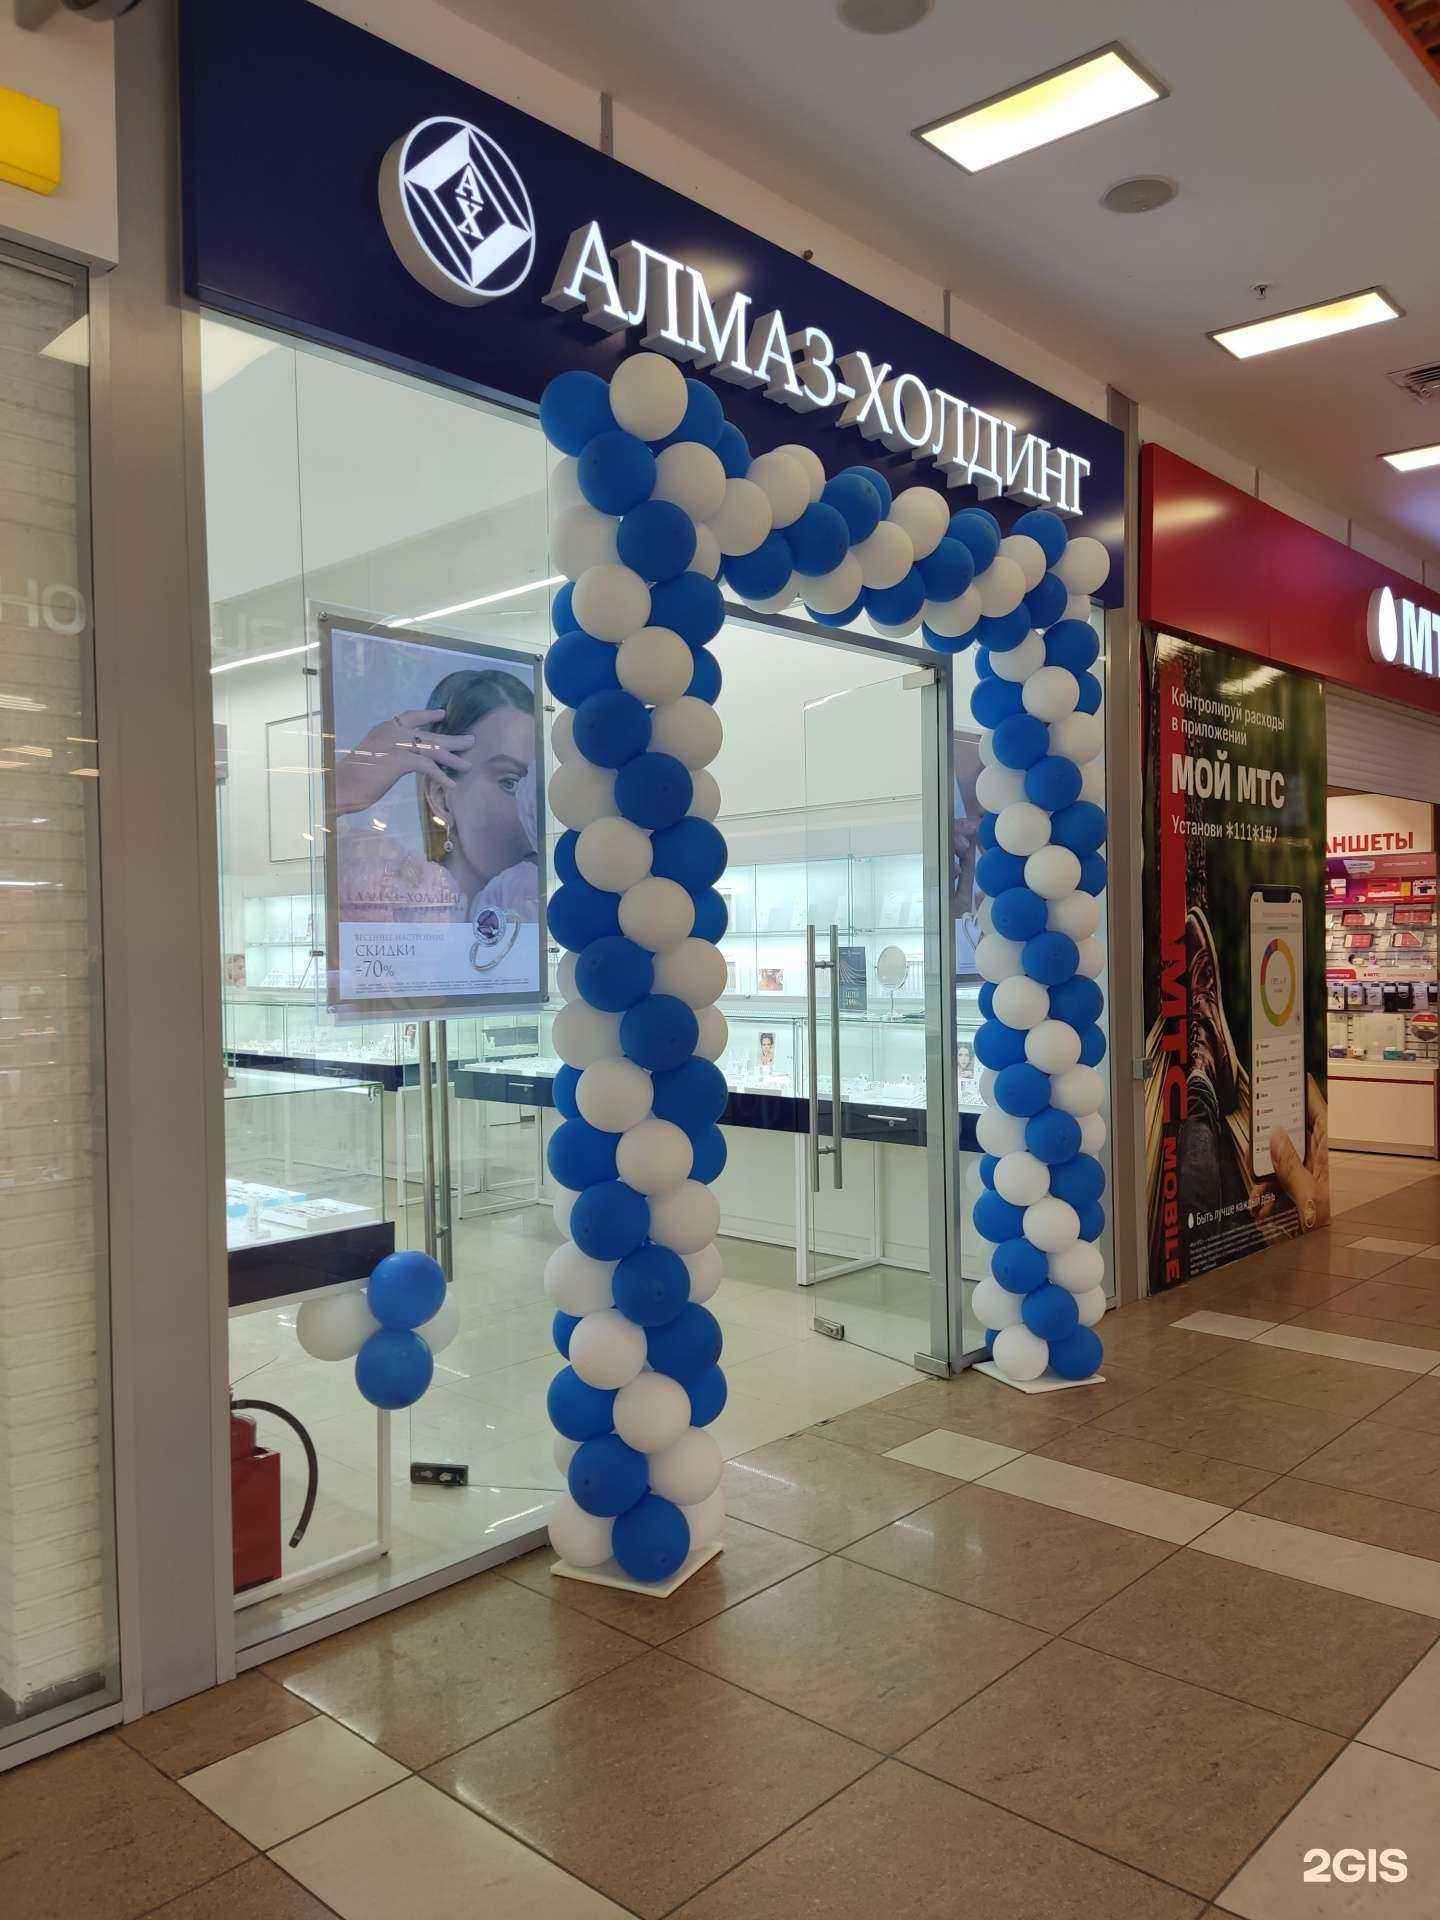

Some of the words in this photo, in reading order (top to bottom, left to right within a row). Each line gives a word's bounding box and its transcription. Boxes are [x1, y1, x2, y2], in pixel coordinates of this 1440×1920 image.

[562, 220, 1092, 515] АЛМАЗ-ХОЛДИНГ
[1171, 686, 1243, 723] Контролируй
[1244, 709, 1285, 732] расходы
[1171, 717, 1179, 731] в
[1181, 718, 1248, 746] приложении
[1172, 749, 1231, 801] МОЙ
[1237, 765, 1285, 809] МТС
[1171, 815, 1223, 838] Установи
[355, 944, 416, 957] СКИДКИ
[355, 959, 395, 978] -70%
[1162, 1137, 1181, 1282] MOBILE
[1196, 1211, 1214, 1226] Быть
[1214, 1204, 1235, 1223] лучше
